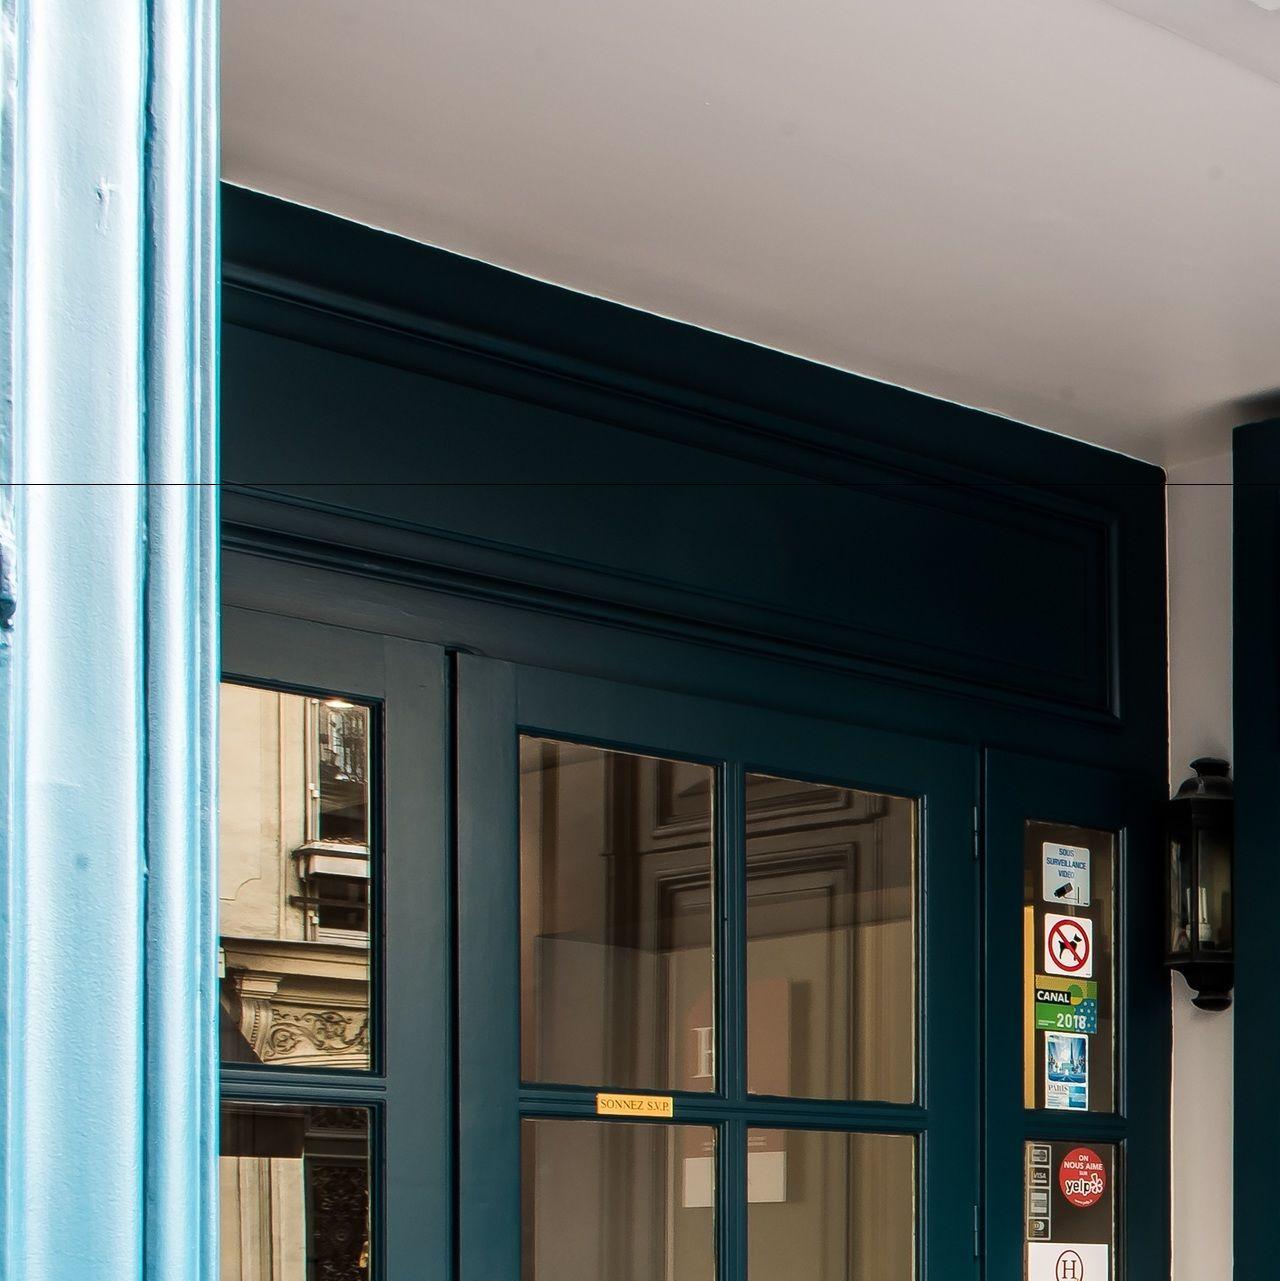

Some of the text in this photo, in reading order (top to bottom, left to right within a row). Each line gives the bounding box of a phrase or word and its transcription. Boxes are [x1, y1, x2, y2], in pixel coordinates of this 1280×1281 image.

[1058, 848, 1075, 857] SOUS
[1046, 857, 1087, 870] SURVEILLANCE
[1037, 990, 1070, 1003] CANAL
[1056, 1013, 1087, 1030] 2018
[600, 1098, 669, 1112] SONNEZ S.V.P.
[1063, 1161, 1104, 1171] NOUS AIME
[1065, 1179, 1091, 1196] yelp
[1062, 1260, 1077, 1279] H
